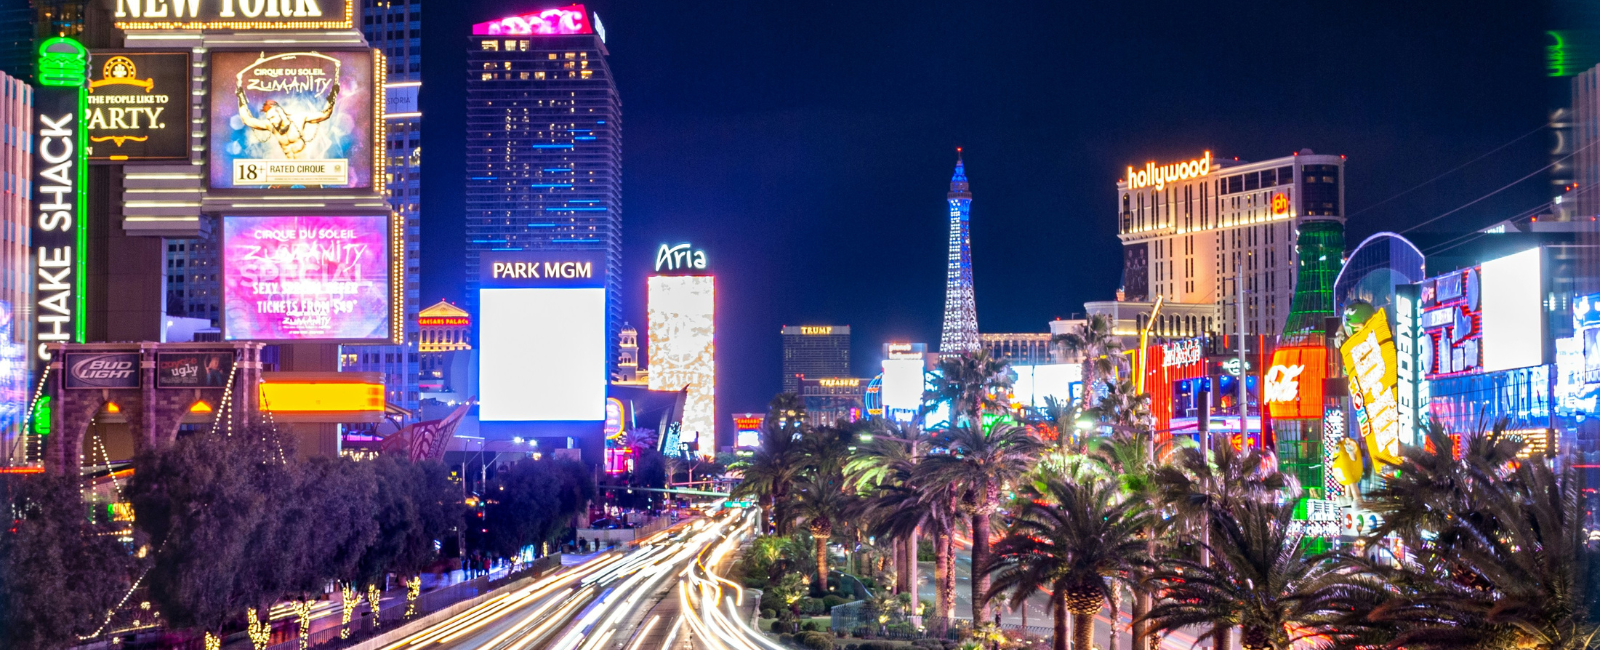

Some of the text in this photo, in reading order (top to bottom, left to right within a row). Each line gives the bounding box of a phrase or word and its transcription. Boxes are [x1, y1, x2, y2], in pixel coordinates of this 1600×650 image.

[254, 68, 326, 78] CIRQUE DU SOLEIL
[87, 95, 169, 104] THE PEOPLE LIKE TO
[39, 112, 74, 233] SHACK
[269, 164, 296, 174] RATED
[296, 164, 326, 174] CIRQUE
[1127, 150, 1211, 192] hollywood
[253, 229, 358, 242] CIRQUE DU SOLEIL
[655, 243, 706, 272] Aria
[493, 262, 592, 279] PARK MGM
[252, 281, 279, 295] SEXY
[256, 301, 299, 314] TICKETS
[300, 301, 331, 314] FROM
[801, 326, 832, 335] TRUMP
[89, 360, 133, 370] BUD
[171, 363, 198, 377] ugly
[1396, 294, 1414, 448] SKECHERS
[79, 369, 135, 379] LIGHT
[819, 379, 860, 388] TREASURE
